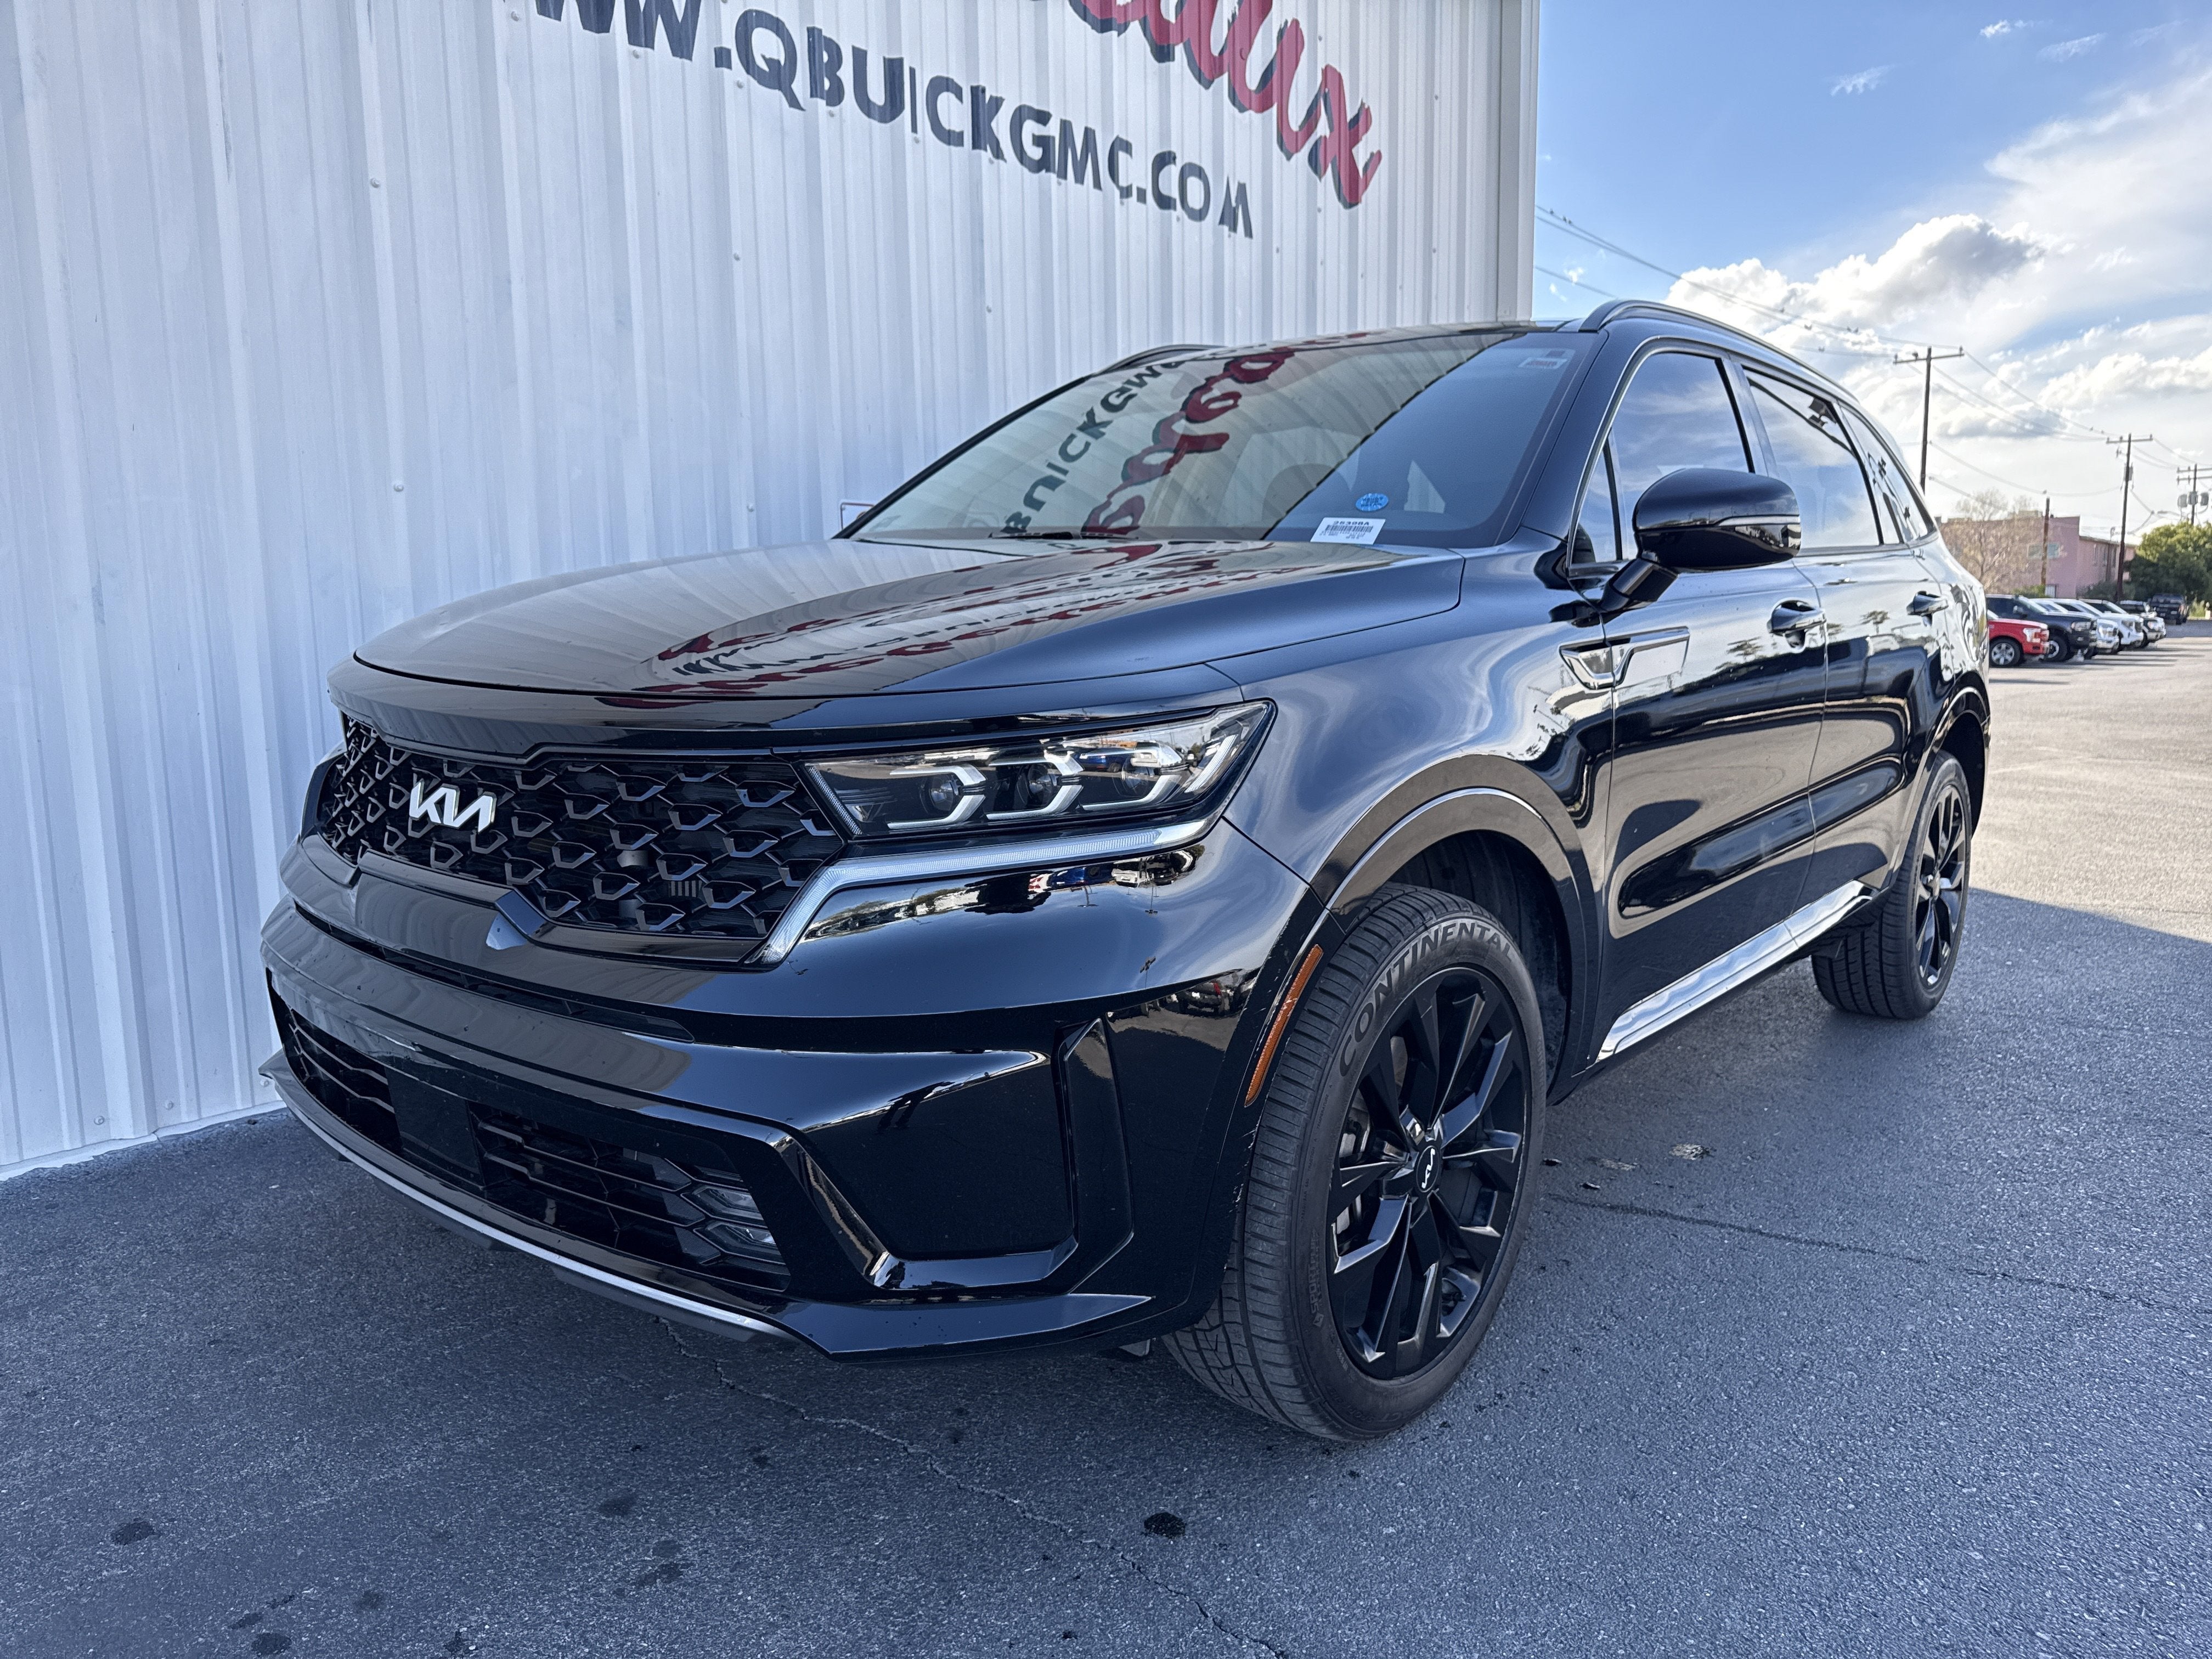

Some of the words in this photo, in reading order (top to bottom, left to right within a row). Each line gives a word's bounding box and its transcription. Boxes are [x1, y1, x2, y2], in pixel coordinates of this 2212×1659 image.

[409, 778, 496, 834] KIA
[1339, 922, 1513, 1076] CONTINENTAL
[1316, 1093, 1329, 1129] TEMPERATURE
